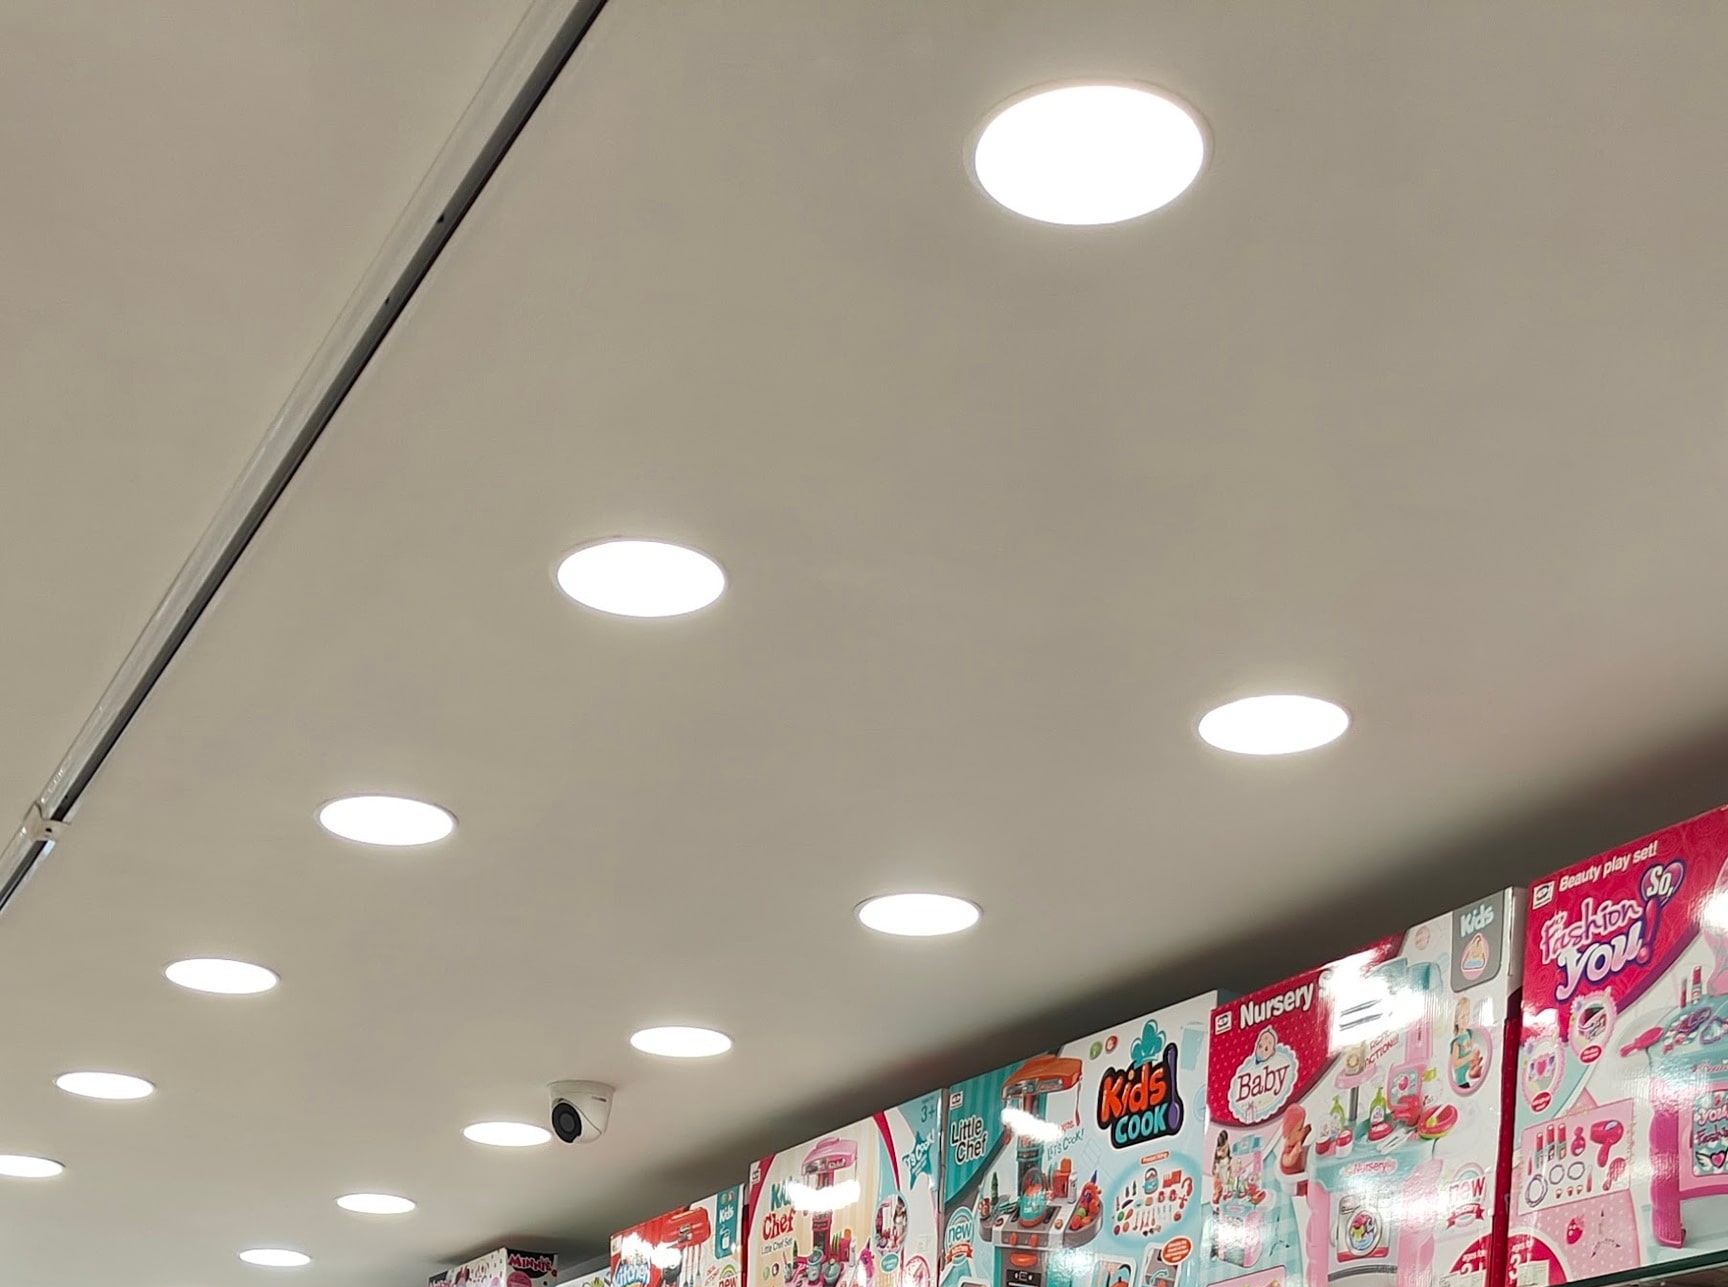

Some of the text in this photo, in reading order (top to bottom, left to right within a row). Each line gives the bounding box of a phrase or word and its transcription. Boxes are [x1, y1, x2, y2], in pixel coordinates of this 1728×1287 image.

[1558, 841, 1658, 892] Beauty play set!
[1459, 902, 1495, 938] Kids
[1541, 899, 1642, 964] Fashion
[1239, 983, 1314, 1030] Nursery
[1101, 1064, 1169, 1123] Kids
[1236, 1060, 1291, 1106] Baby
[920, 1106, 936, 1123] 3+
[950, 1115, 984, 1145] Little
[1114, 1108, 1167, 1147] COOK
[956, 1131, 988, 1166] Chef
[719, 1203, 736, 1223] Kids
[762, 1210, 796, 1241] Chef
[948, 1221, 972, 1244] new
